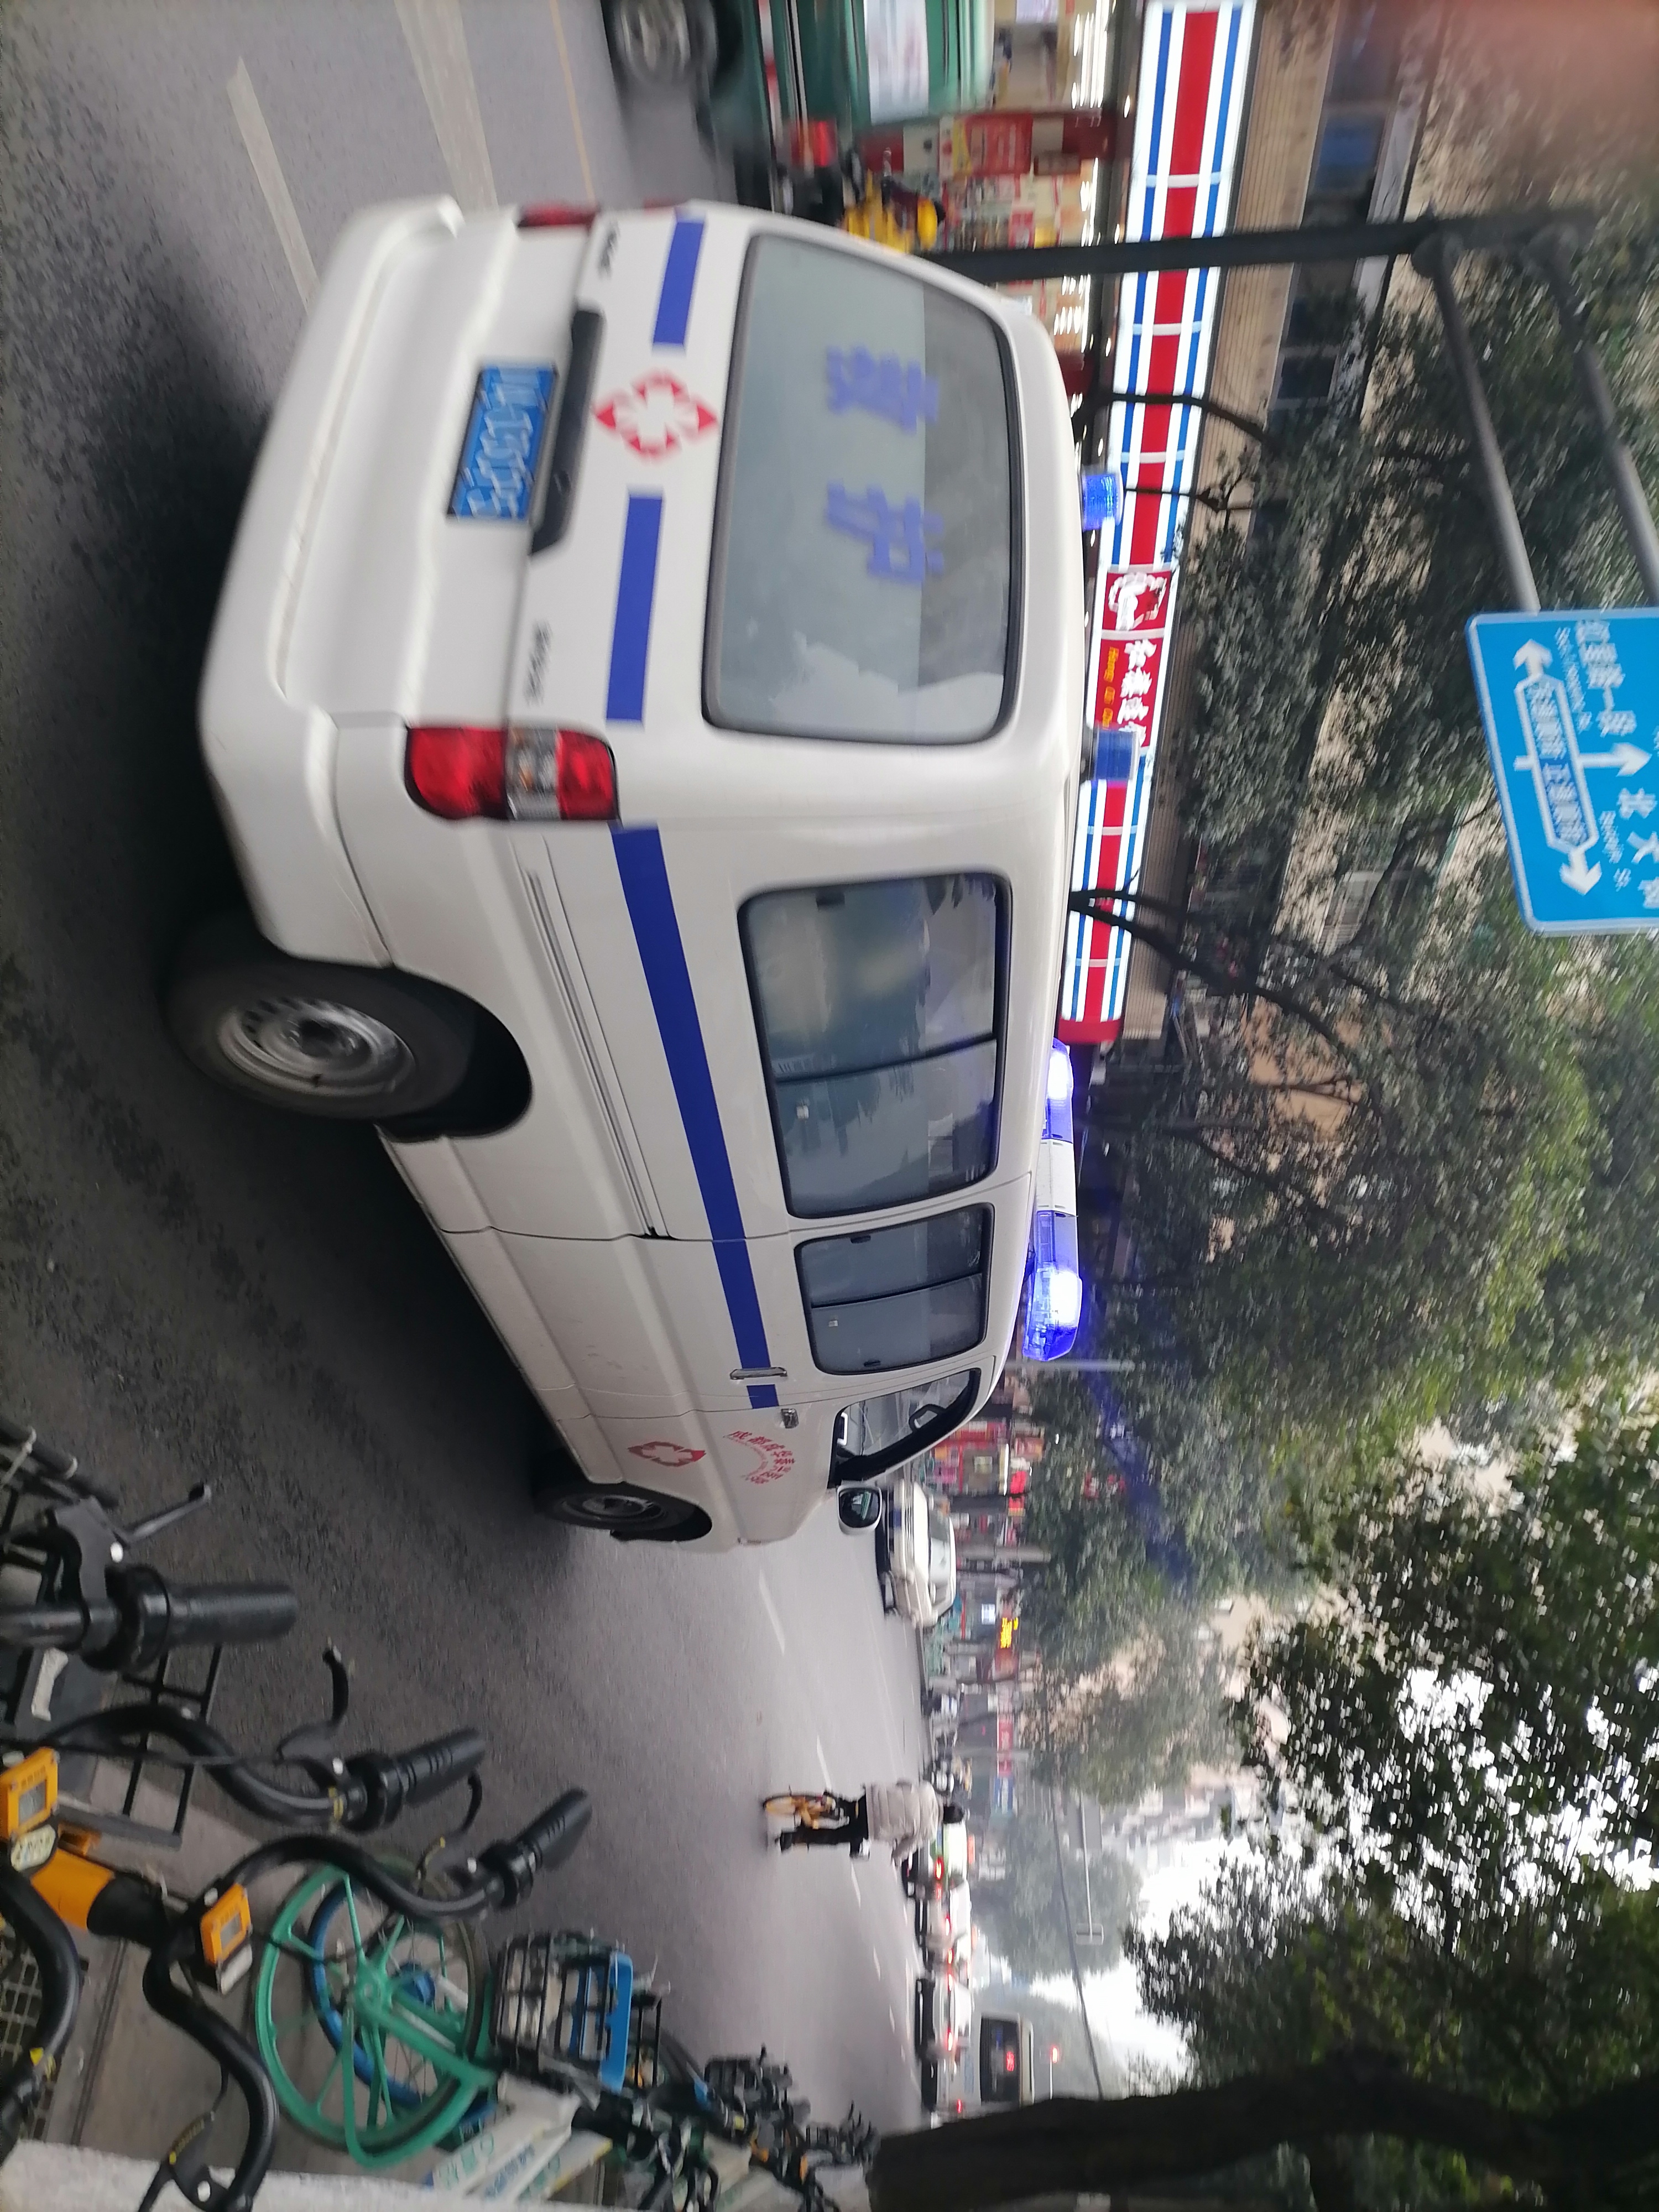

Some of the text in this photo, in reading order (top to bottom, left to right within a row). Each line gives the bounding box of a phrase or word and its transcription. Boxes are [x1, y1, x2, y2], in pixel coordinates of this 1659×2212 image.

[825, 344, 946, 587] 救护
[1575, 620, 1637, 738] 红星路一段
